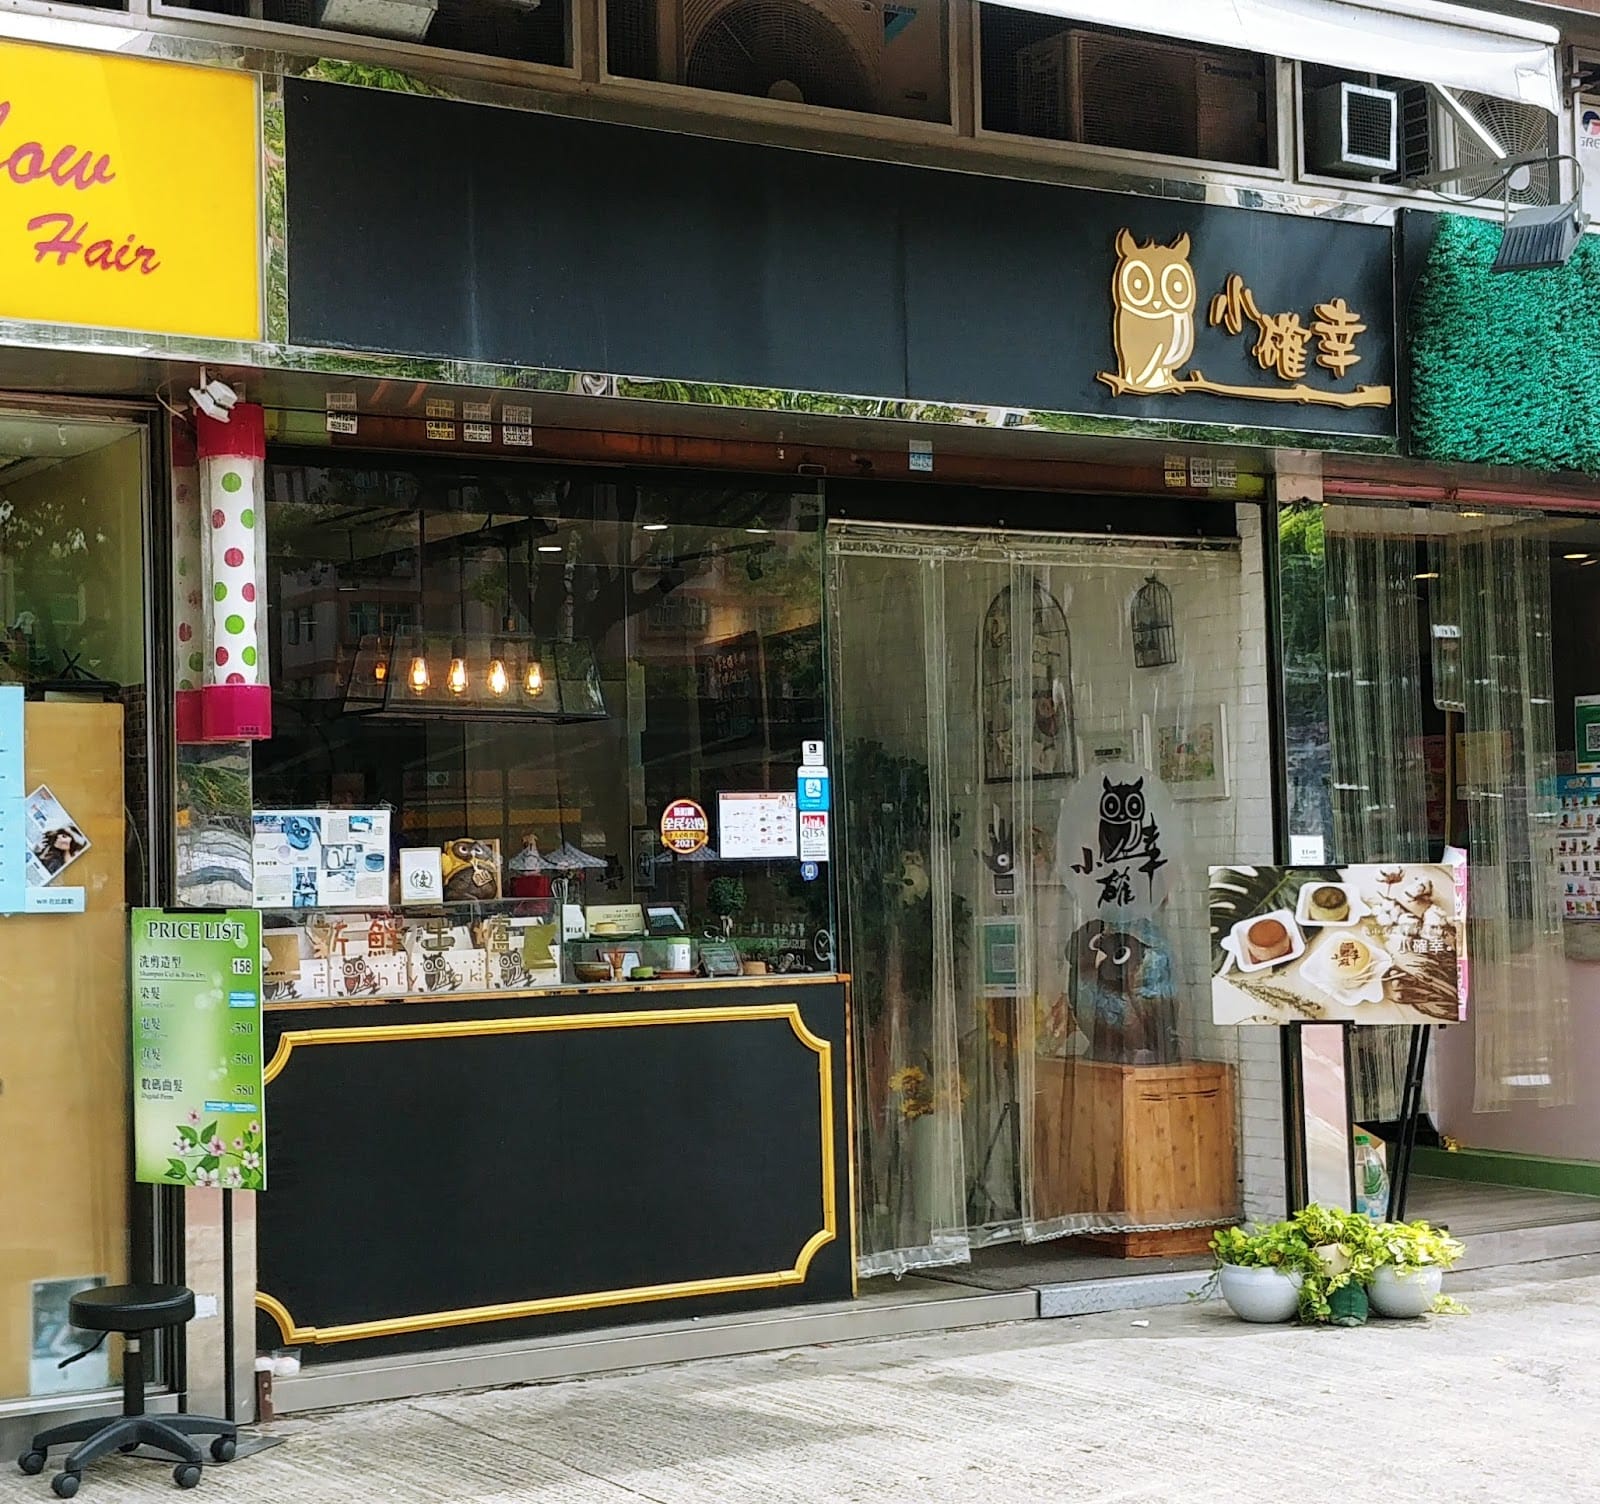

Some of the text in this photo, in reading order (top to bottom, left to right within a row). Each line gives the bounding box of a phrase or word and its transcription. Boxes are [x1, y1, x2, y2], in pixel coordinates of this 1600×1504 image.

[26, 212, 162, 276] Hair
[1208, 272, 1368, 381] 小確幸
[674, 839, 696, 848] 2021
[148, 921, 245, 941] PRICE LIST
[233, 959, 252, 974] 158
